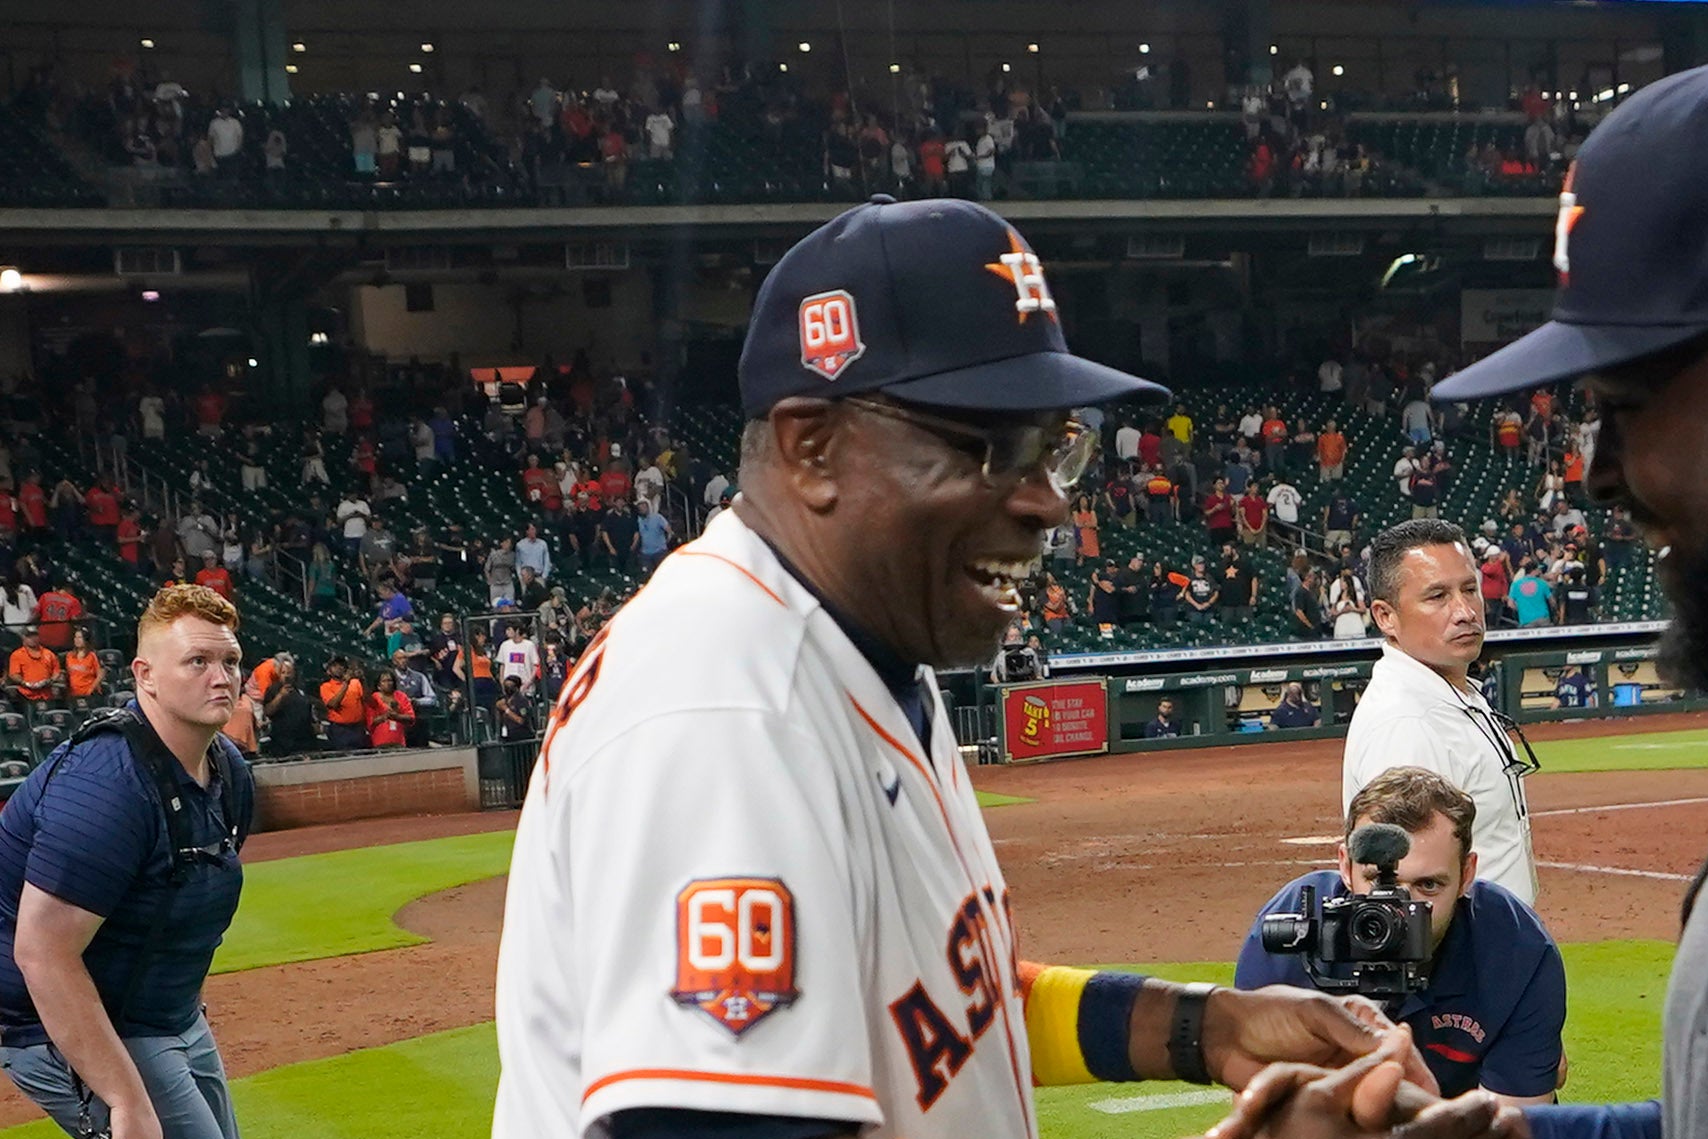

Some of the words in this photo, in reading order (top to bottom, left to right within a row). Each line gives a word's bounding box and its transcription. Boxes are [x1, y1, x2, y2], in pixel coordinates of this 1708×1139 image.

[804, 300, 849, 347] 60
[1126, 678, 1165, 689] Academy
[1025, 717, 1038, 736] 5
[687, 889, 784, 972] 60
[1431, 1013, 1486, 1044] ASTROS
